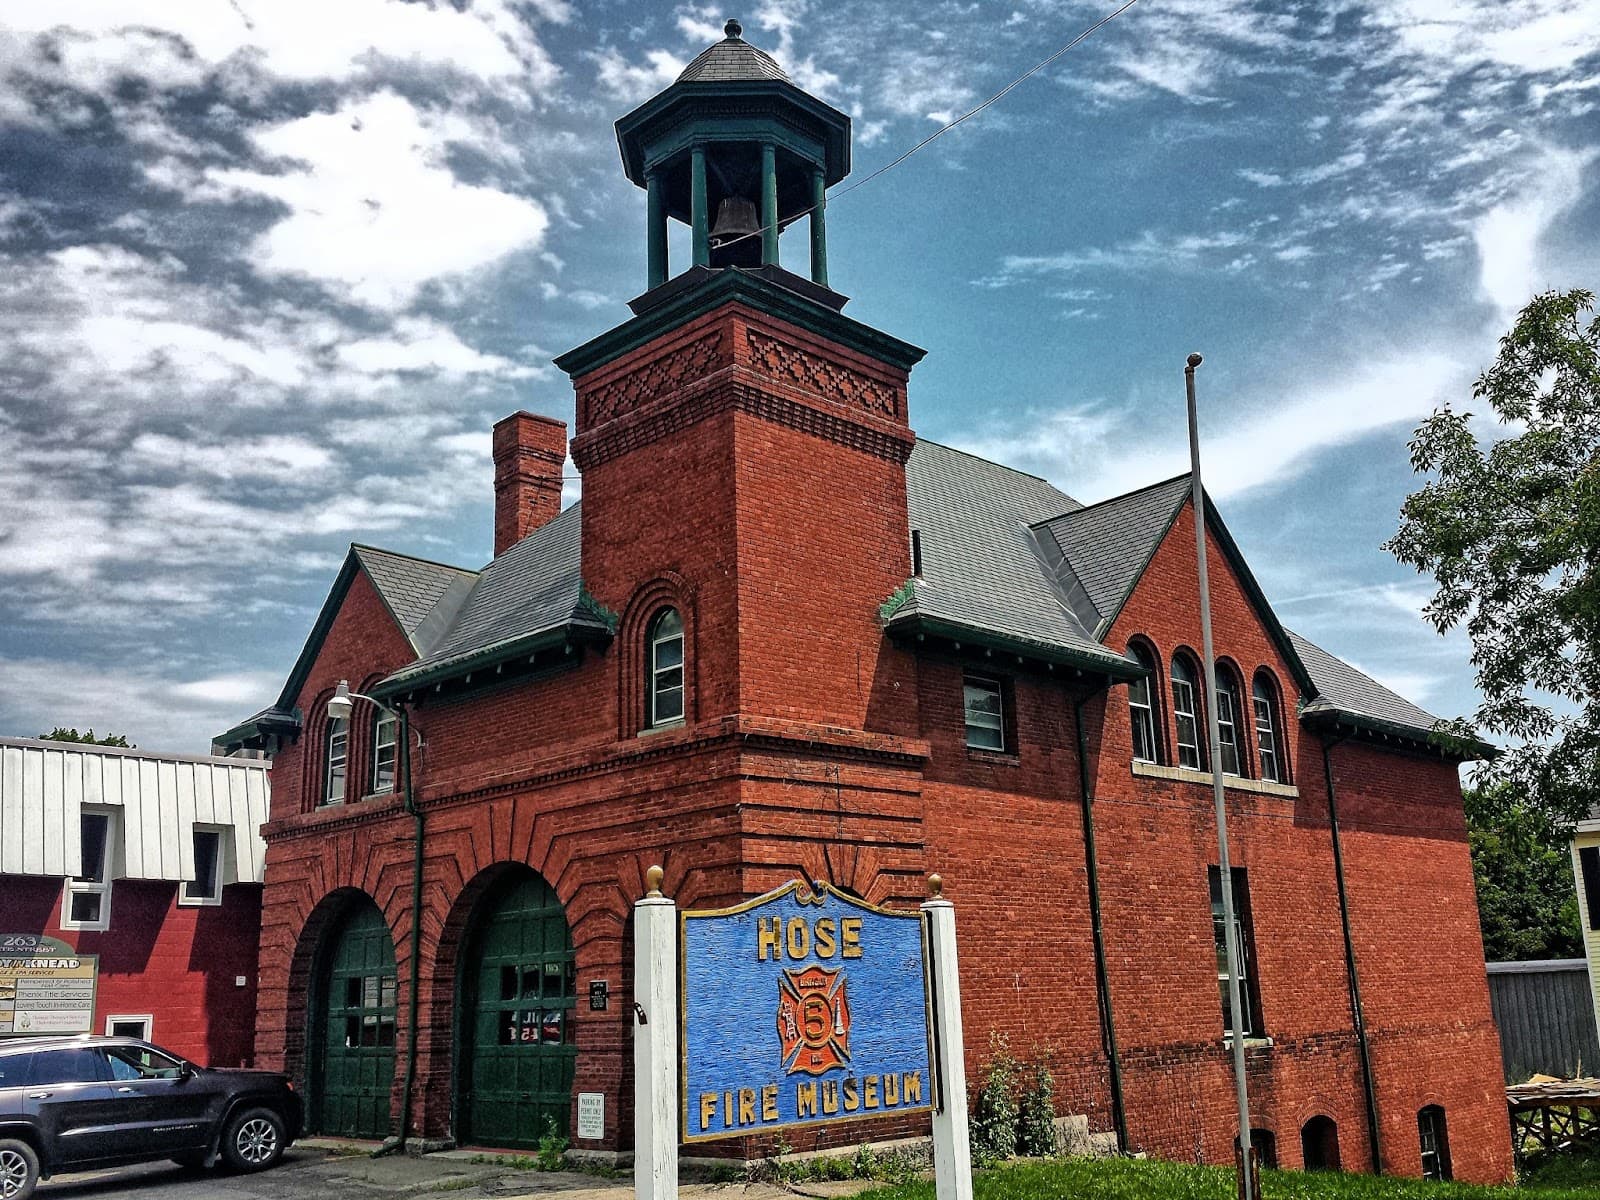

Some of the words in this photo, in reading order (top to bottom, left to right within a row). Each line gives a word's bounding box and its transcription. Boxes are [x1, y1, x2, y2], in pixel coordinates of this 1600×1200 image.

[4, 936, 37, 946] 263
[757, 916, 863, 960] HOSE
[805, 1000, 825, 1038] 5
[700, 1083, 779, 1129] FIRE
[797, 1071, 921, 1117] MUSEUM
